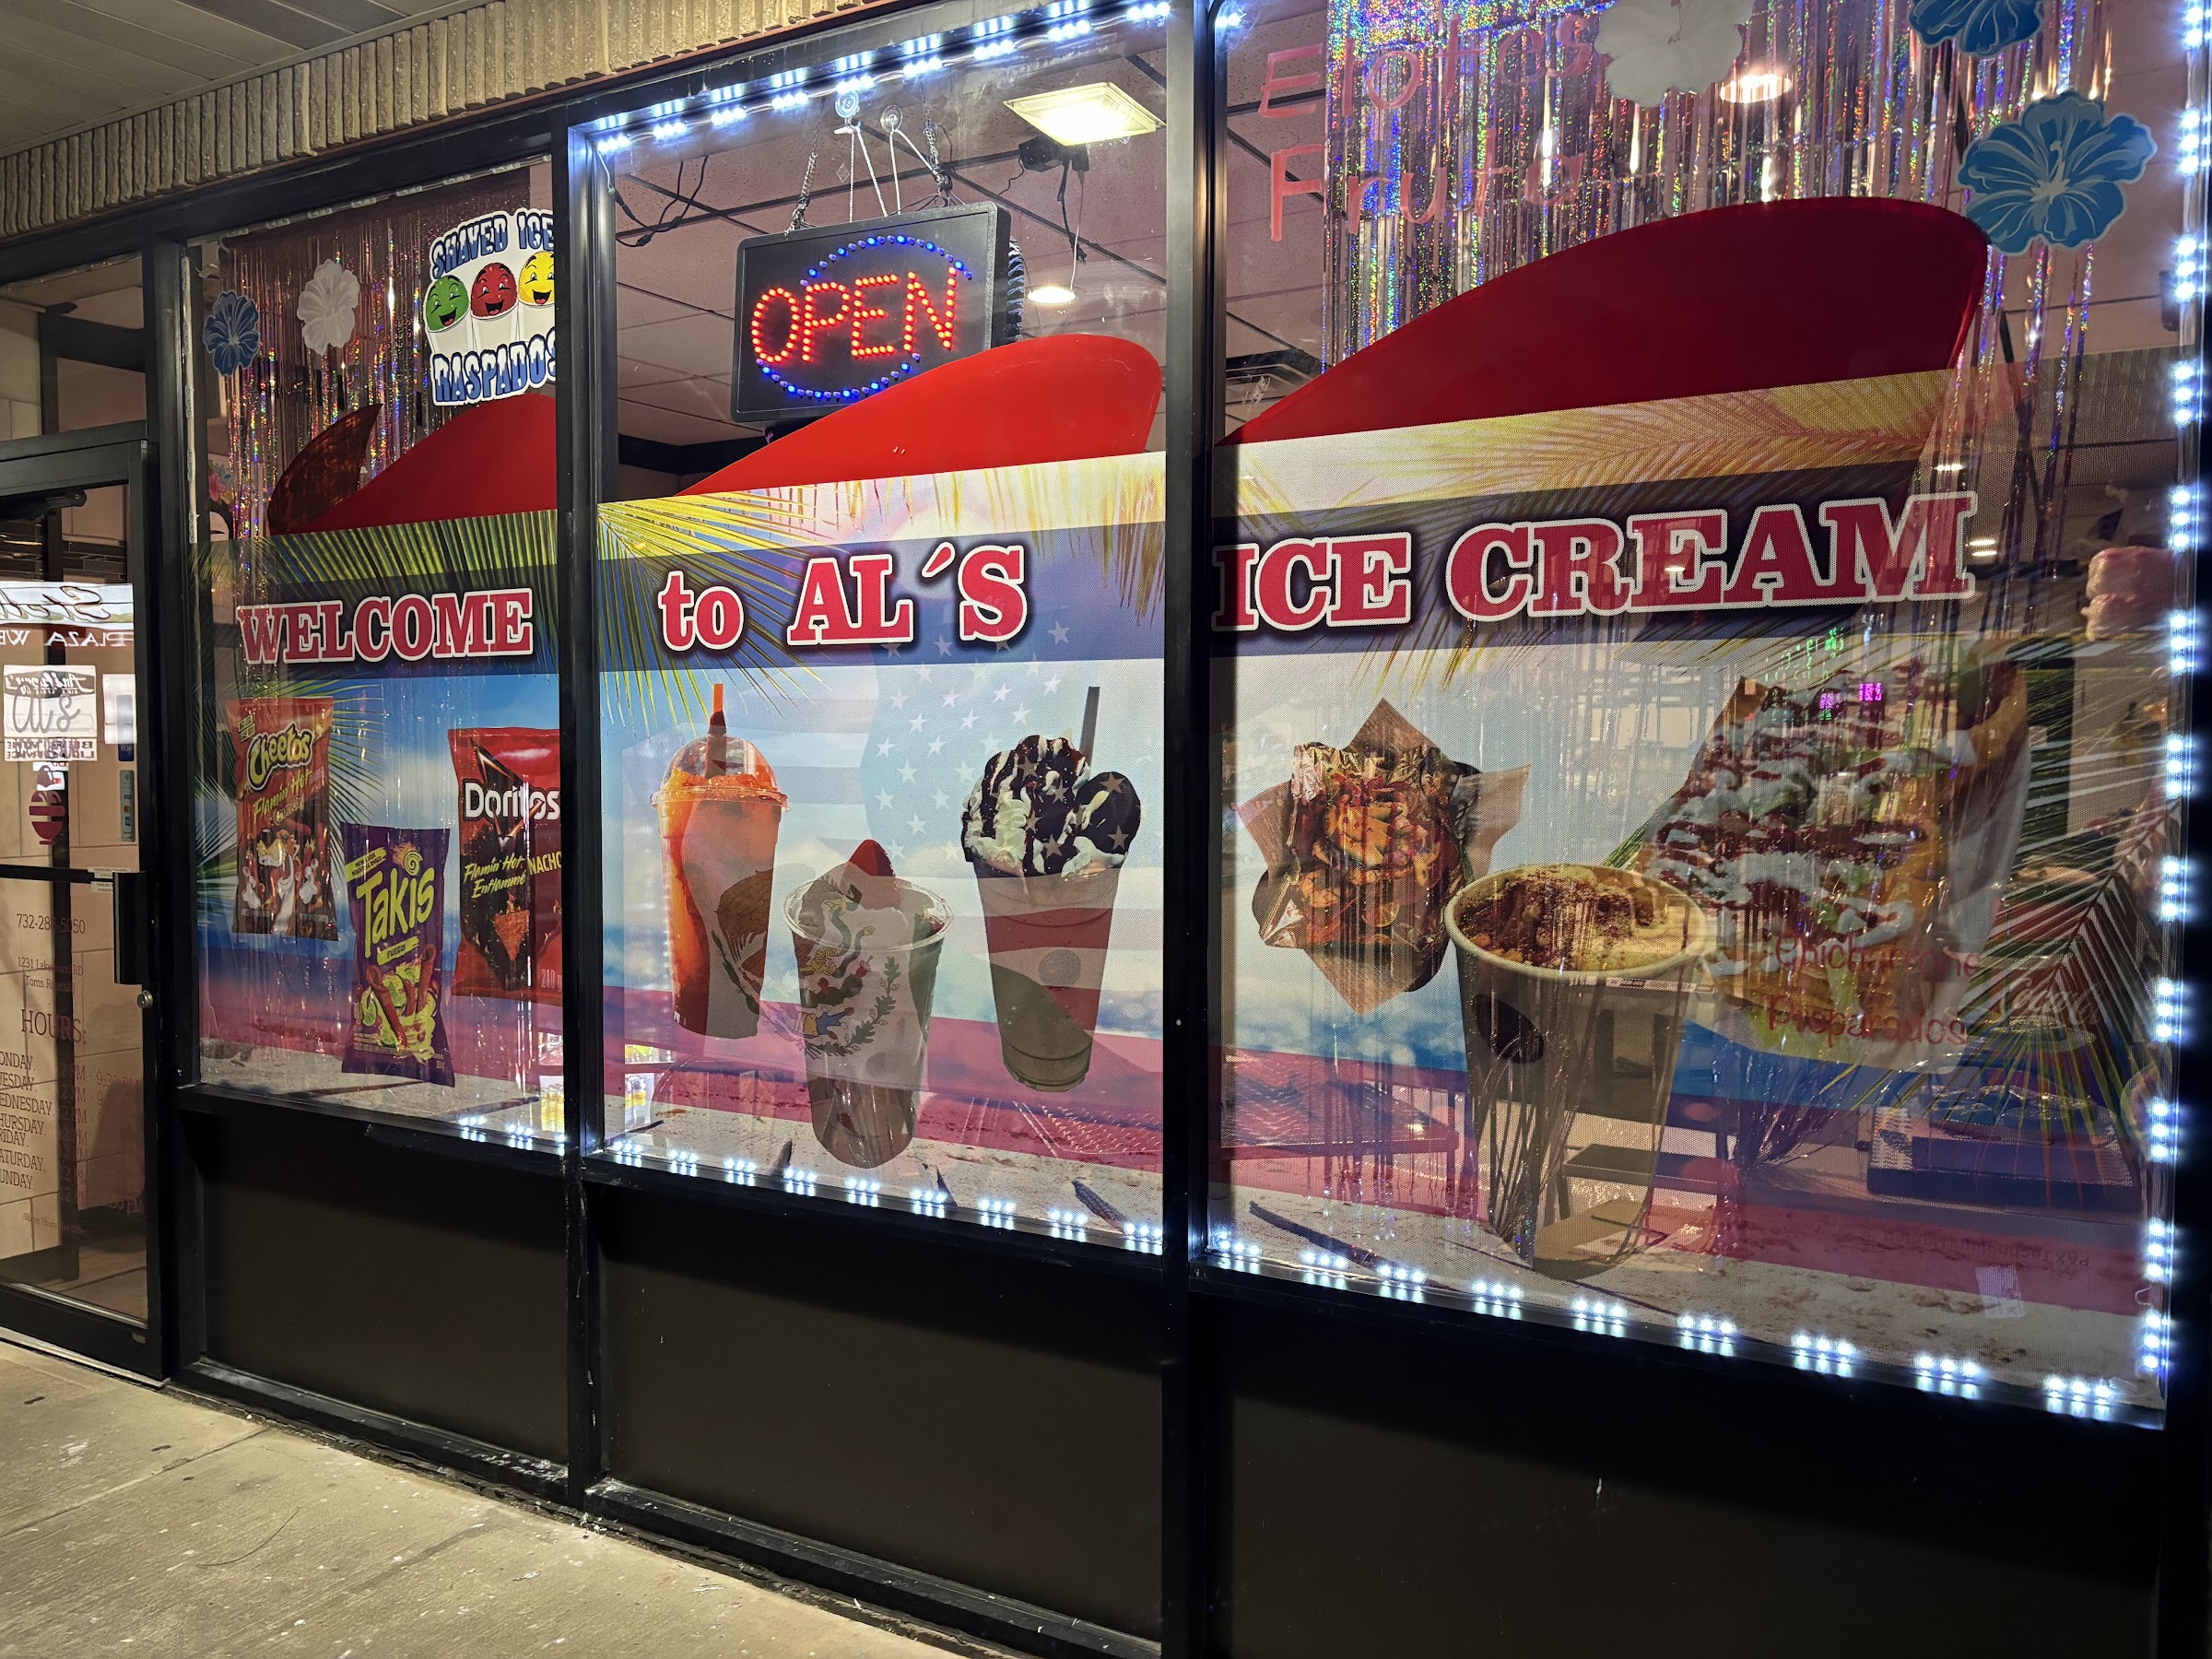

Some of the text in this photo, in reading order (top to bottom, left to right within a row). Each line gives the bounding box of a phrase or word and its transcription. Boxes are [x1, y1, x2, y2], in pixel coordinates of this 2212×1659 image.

[1257, 13, 1592, 118] Elotes
[431, 211, 554, 280] SHAVED ICE
[750, 265, 959, 364] OPEN
[432, 326, 556, 404] RASPADOS
[1212, 490, 1978, 631] ICE CREAM
[236, 587, 533, 665] WELCOME
[658, 571, 744, 651] to
[247, 723, 314, 790] Cheetos
[291, 768, 313, 795] Hot
[464, 782, 561, 821] Doritos
[502, 852, 526, 871] Hot
[527, 851, 562, 875] NACHO
[356, 867, 435, 959] Takis
[18, 957, 33, 970] 1231
[73, 964, 84, 976] RD
[26, 976, 45, 989] Toms
[541, 969, 556, 989] 210
